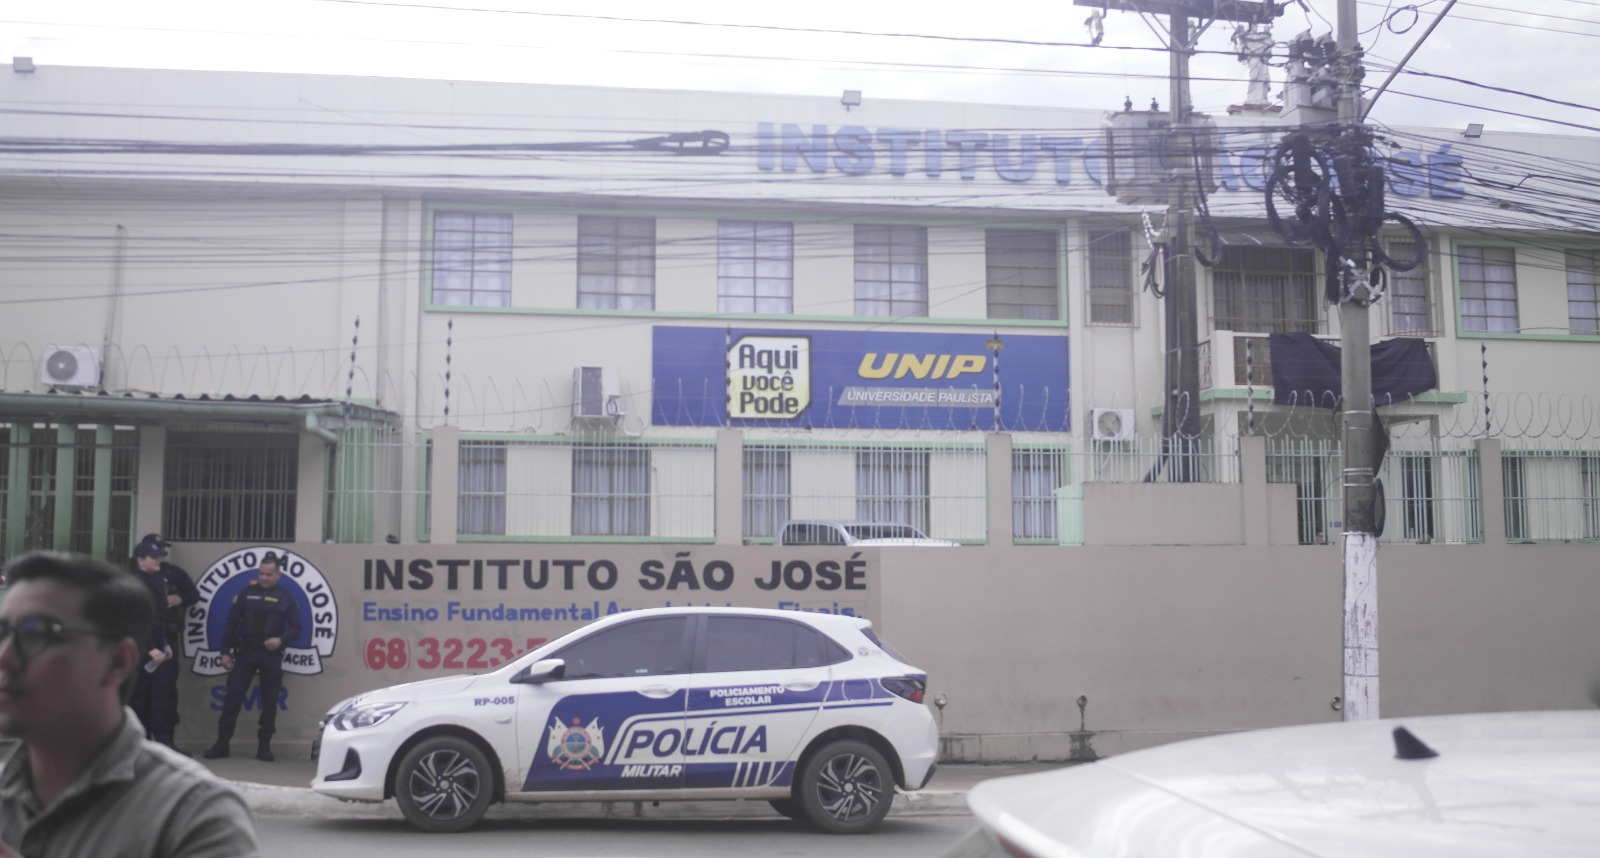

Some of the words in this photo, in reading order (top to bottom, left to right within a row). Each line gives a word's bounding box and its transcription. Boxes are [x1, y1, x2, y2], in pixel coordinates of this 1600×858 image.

[738, 344, 798, 374] Aqui
[857, 352, 987, 380] UNIP
[742, 370, 794, 391] você
[740, 391, 799, 414] Pode
[847, 389, 937, 403] UNIVERSIDADE
[938, 391, 993, 403] PAULISTA
[363, 559, 618, 591] INSTITUTO
[638, 553, 735, 590] SÃO
[754, 552, 867, 590] JOSÉ
[305, 581, 334, 640] JOSÉ
[363, 602, 440, 622] Ensino
[448, 601, 600, 622] Fundamental
[284, 652, 315, 667] ACRE
[363, 637, 411, 671] (68)
[474, 696, 516, 706] RP-005
[709, 686, 785, 698] POLICIAMENTO
[725, 695, 772, 707] ESCOLAR
[624, 720, 768, 759] POLÍCIA
[621, 765, 683, 778] MILITAR
